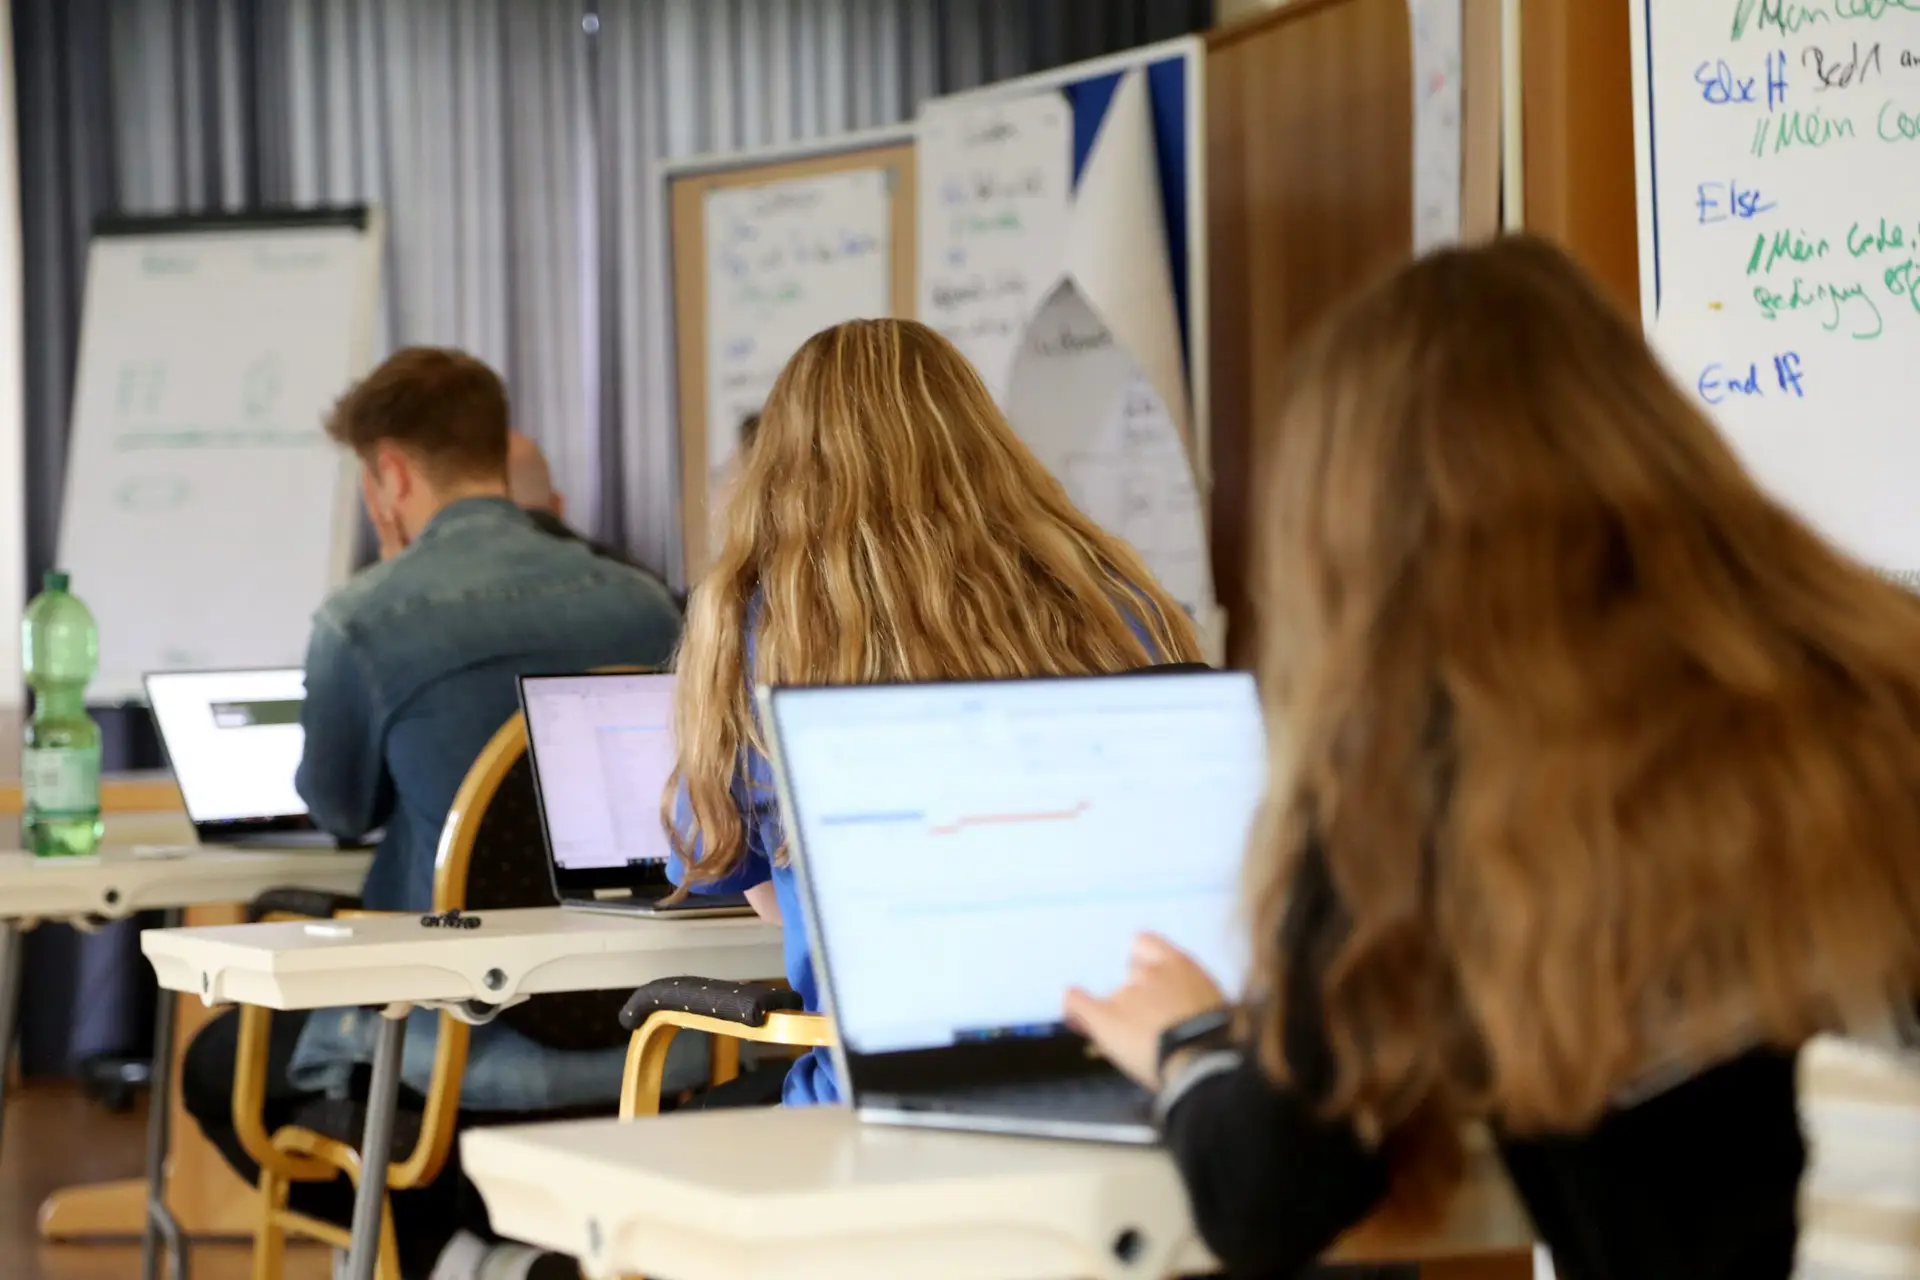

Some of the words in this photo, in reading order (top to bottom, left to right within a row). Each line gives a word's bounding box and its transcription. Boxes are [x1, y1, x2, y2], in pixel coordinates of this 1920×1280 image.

[1696, 178, 1777, 224] Else
[1698, 362, 1761, 404] End
[1774, 351, 1804, 397] If
